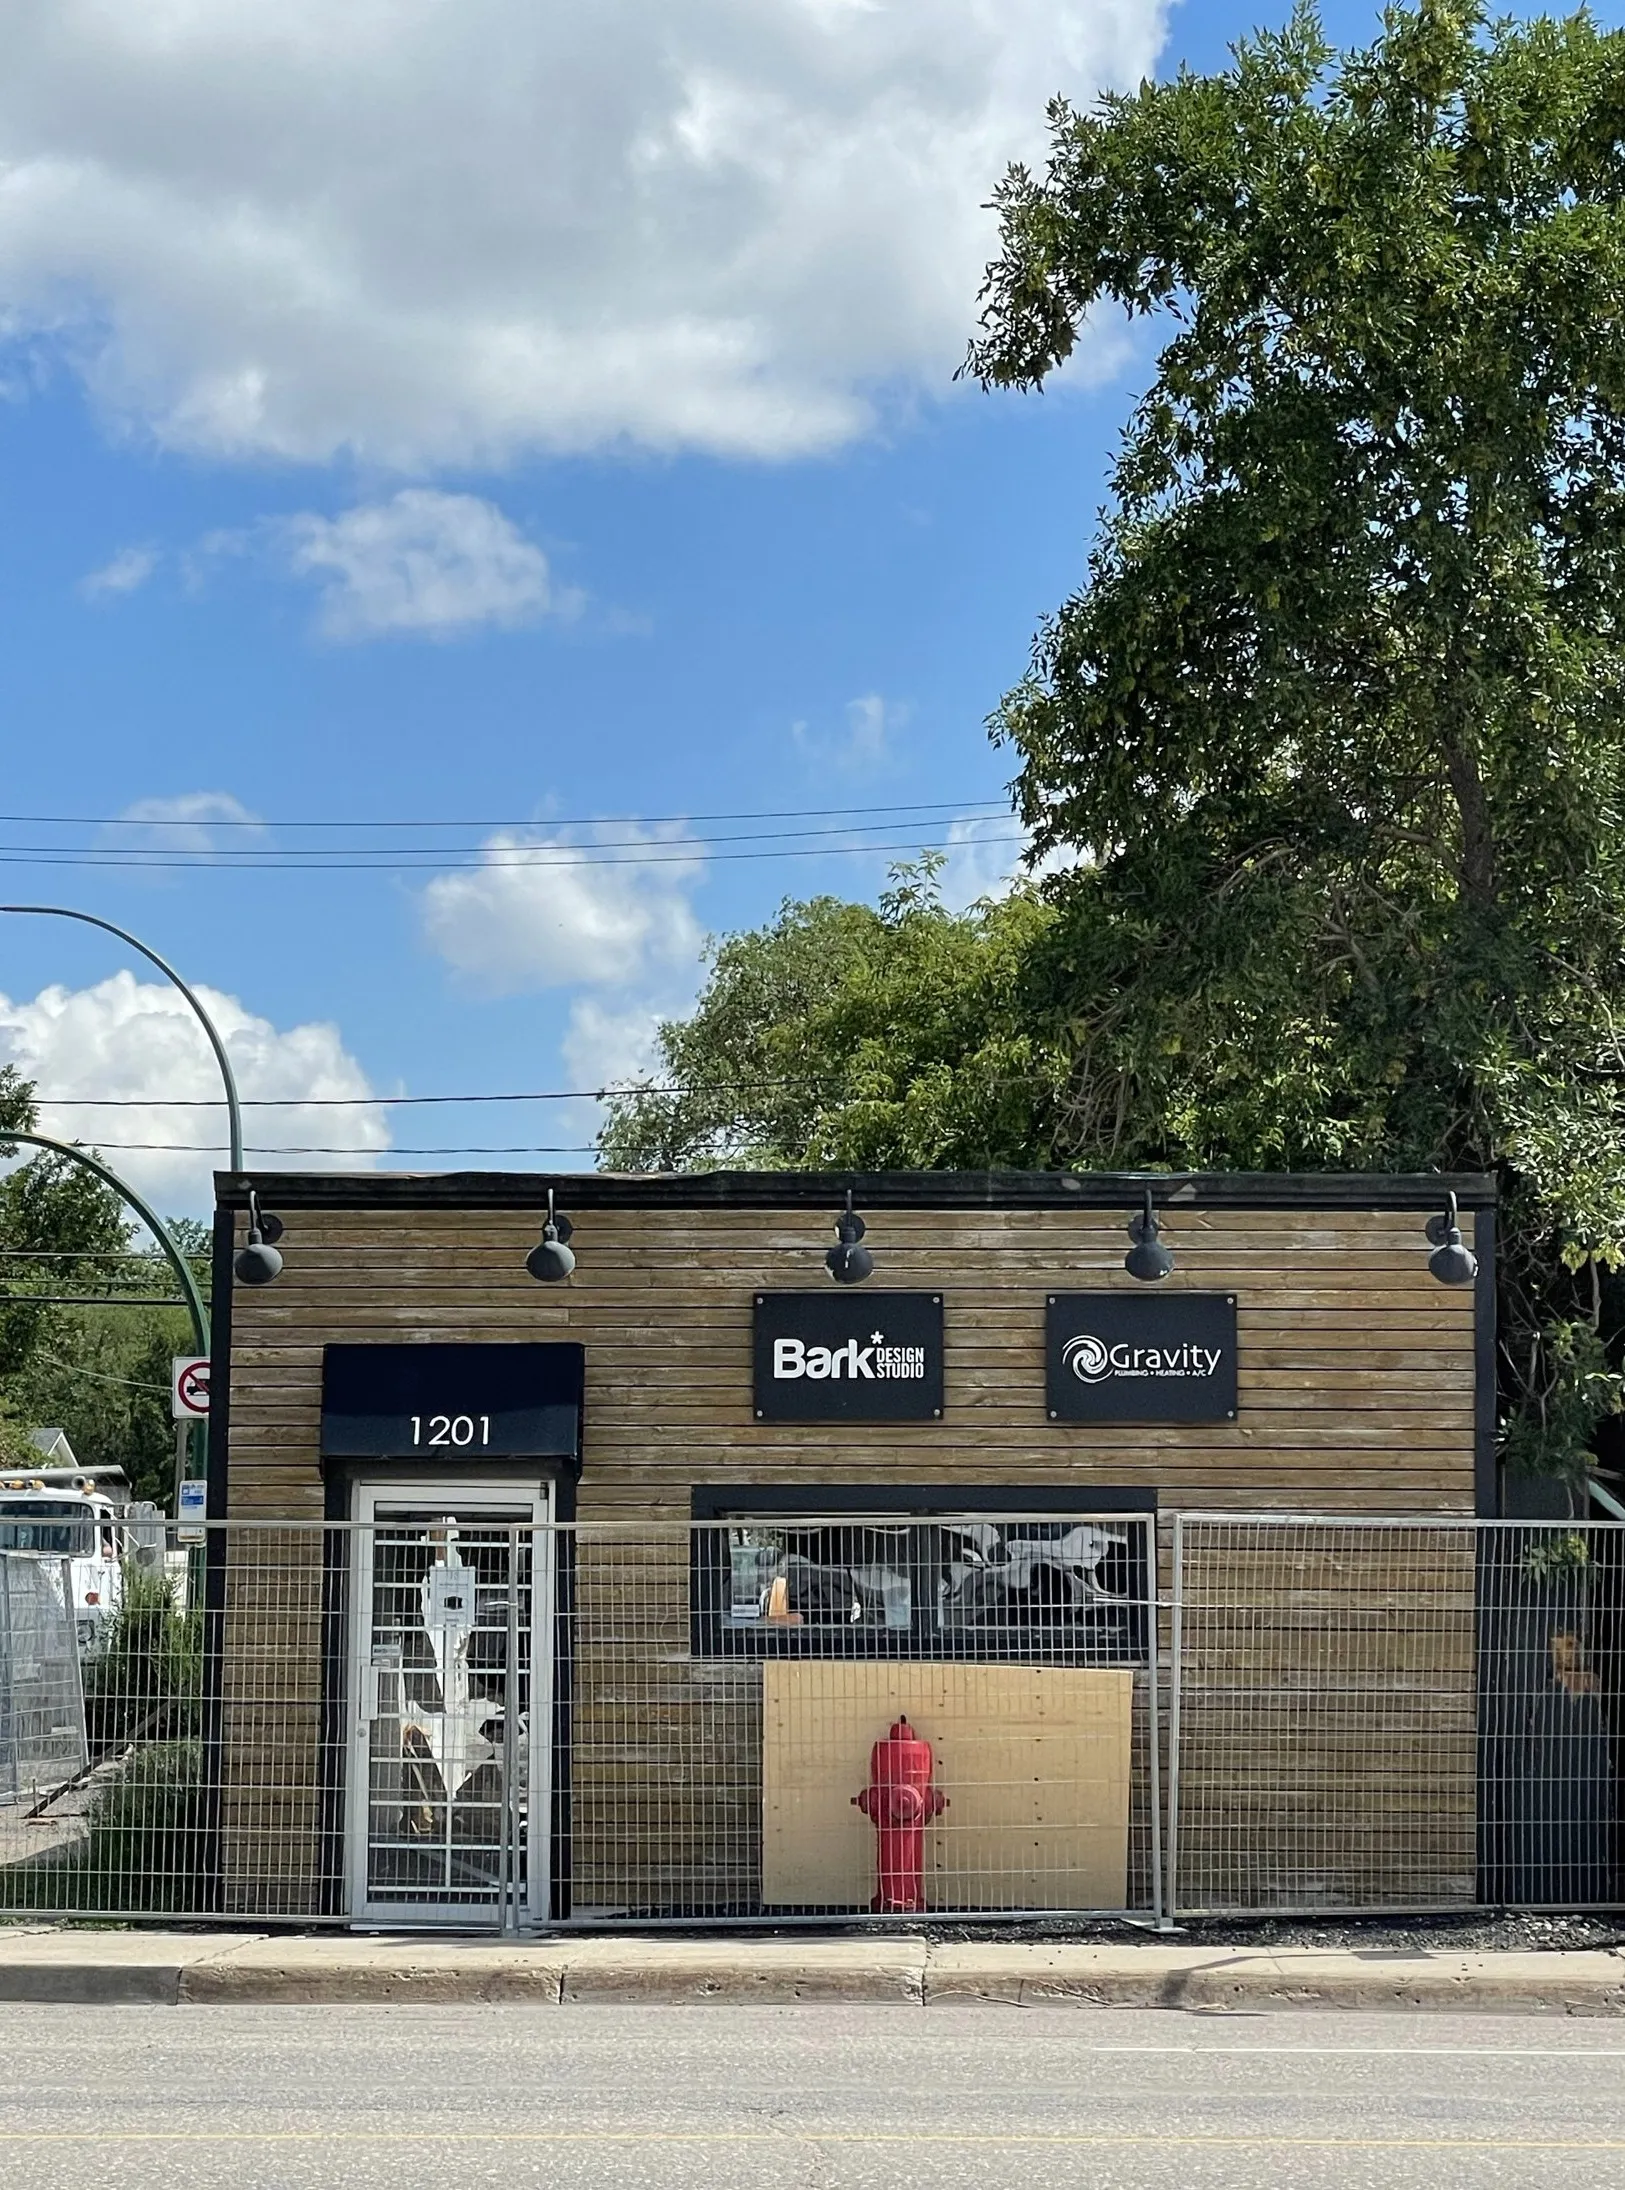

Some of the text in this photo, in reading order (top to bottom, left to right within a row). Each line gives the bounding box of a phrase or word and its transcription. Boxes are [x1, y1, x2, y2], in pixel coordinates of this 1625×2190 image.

[773, 1338, 876, 1379] Bark
[876, 1347, 925, 1363] DESIGN
[1109, 1343, 1222, 1376] Gravity
[876, 1362, 925, 1379] STUDIO
[1114, 1369, 1207, 1377] PLUMBING HEATING A/C
[410, 1415, 489, 1446] 1201
